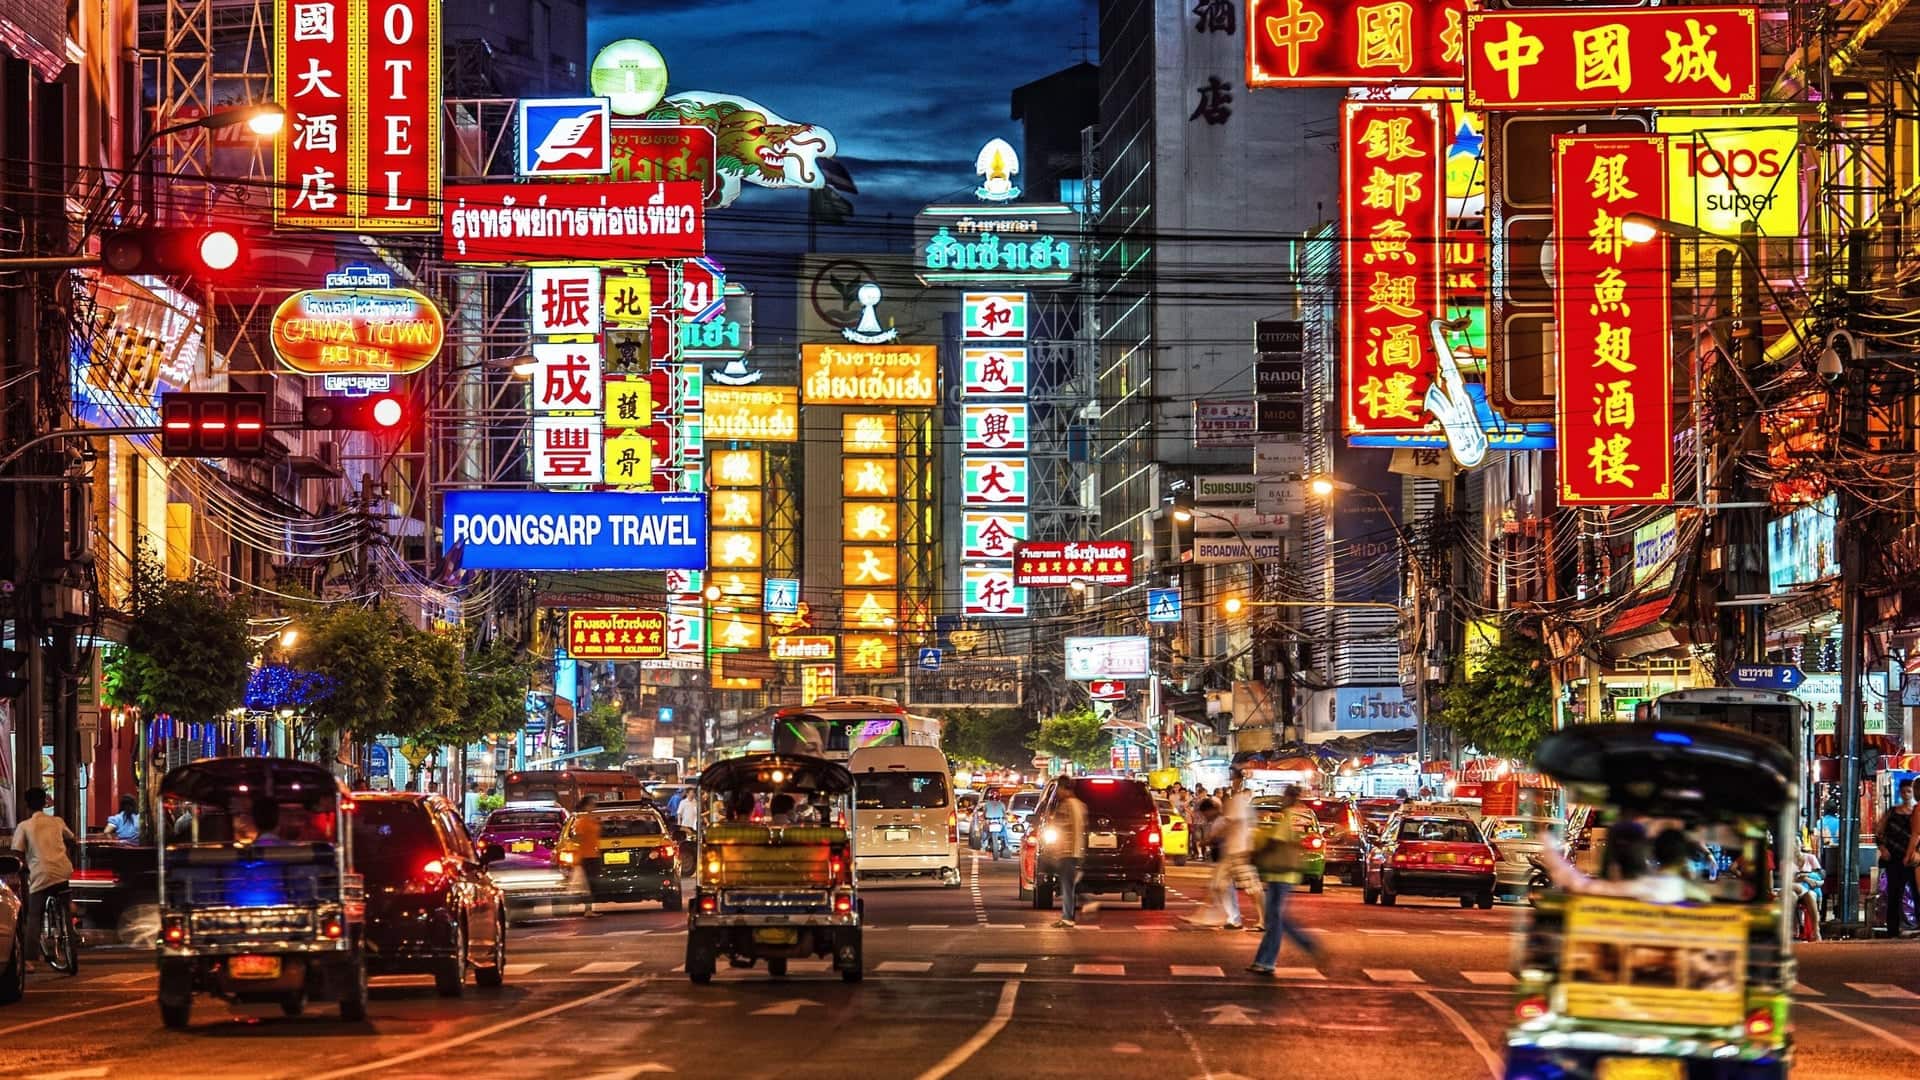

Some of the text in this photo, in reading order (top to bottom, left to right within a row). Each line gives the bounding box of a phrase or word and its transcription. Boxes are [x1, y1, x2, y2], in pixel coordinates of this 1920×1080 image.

[1483, 19, 1732, 100] 中國城
[1676, 141, 1781, 192] Tops
[1705, 191, 1779, 217] super
[451, 183, 695, 255] รุ่งทรัพย์การท่องเที่ยว
[1358, 117, 1426, 422] 銀都魚翅酒樓
[283, 319, 434, 345] CHINA TOWN
[1584, 154, 1641, 489] 銀都魚翅酒樓
[1259, 333, 1300, 343] CITIZEN
[541, 278, 592, 477] 振成豐
[1260, 371, 1301, 382] RADO
[1263, 411, 1297, 420] MIDO
[979, 301, 1013, 609] 和成興大金行
[1268, 490, 1293, 498] BALL
[453, 514, 697, 546] ROONGSARP TRAVEL
[1199, 544, 1280, 558] BROADWAY HOTE
[1782, 670, 1793, 684] 2
